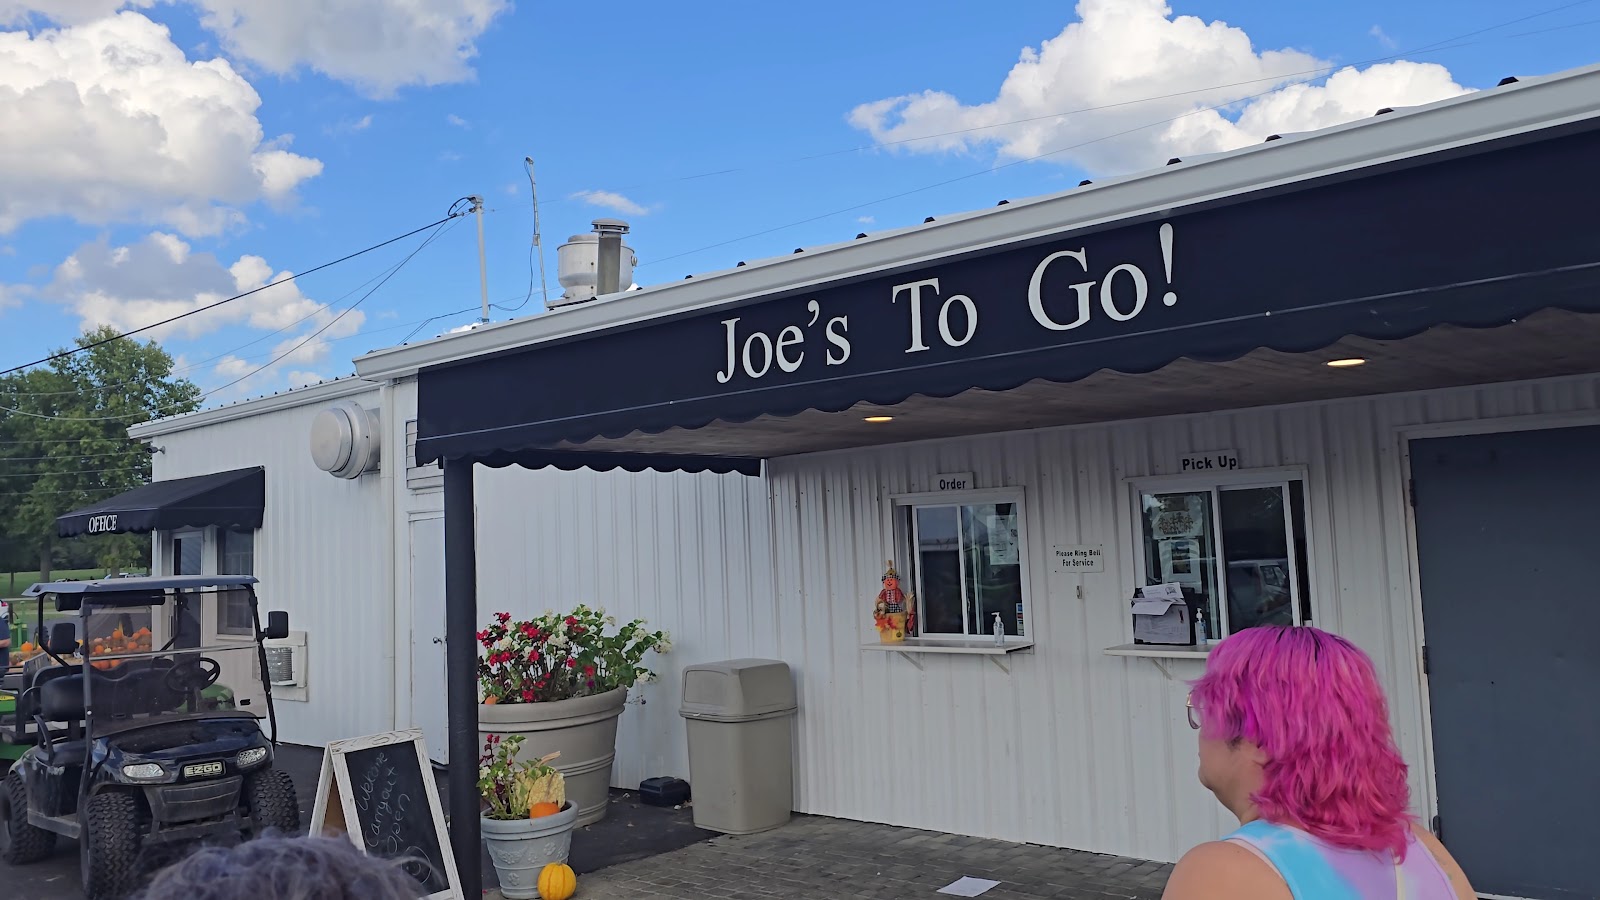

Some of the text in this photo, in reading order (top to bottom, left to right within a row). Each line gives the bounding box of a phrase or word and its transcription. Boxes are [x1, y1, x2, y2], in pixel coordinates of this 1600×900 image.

[716, 223, 1178, 384] Joe's To Go!
[1182, 455, 1237, 471] Pick Up
[939, 478, 966, 490] Order
[88, 514, 118, 533] OFFICE
[1074, 549, 1087, 557] Ring
[1062, 558, 1094, 567] For Service
